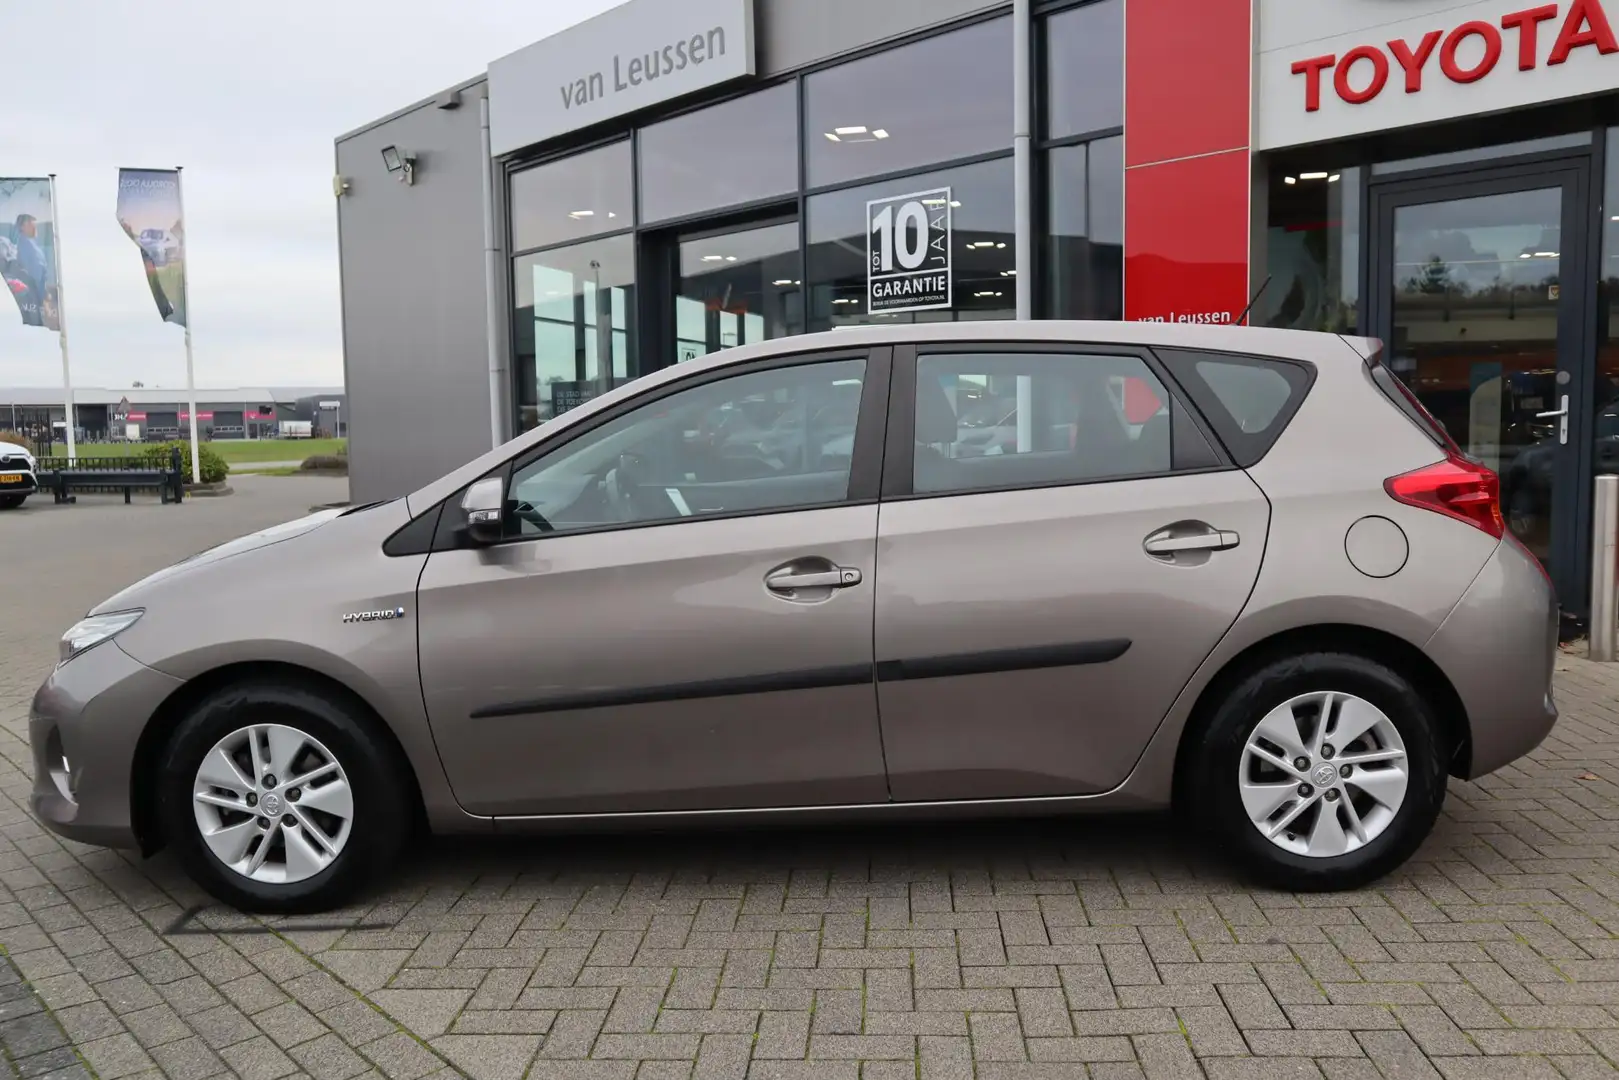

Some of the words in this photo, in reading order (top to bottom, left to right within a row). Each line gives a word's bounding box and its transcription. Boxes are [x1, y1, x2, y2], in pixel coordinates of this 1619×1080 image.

[560, 72, 604, 110] van
[613, 26, 726, 92] Leussen
[1291, 0, 1619, 112] TOYOTA
[872, 201, 929, 272] 10
[930, 196, 945, 264] JAAR
[873, 276, 946, 297] GARANTIE
[1170, 311, 1231, 324] Leussen
[343, 609, 394, 624] HYBRID
